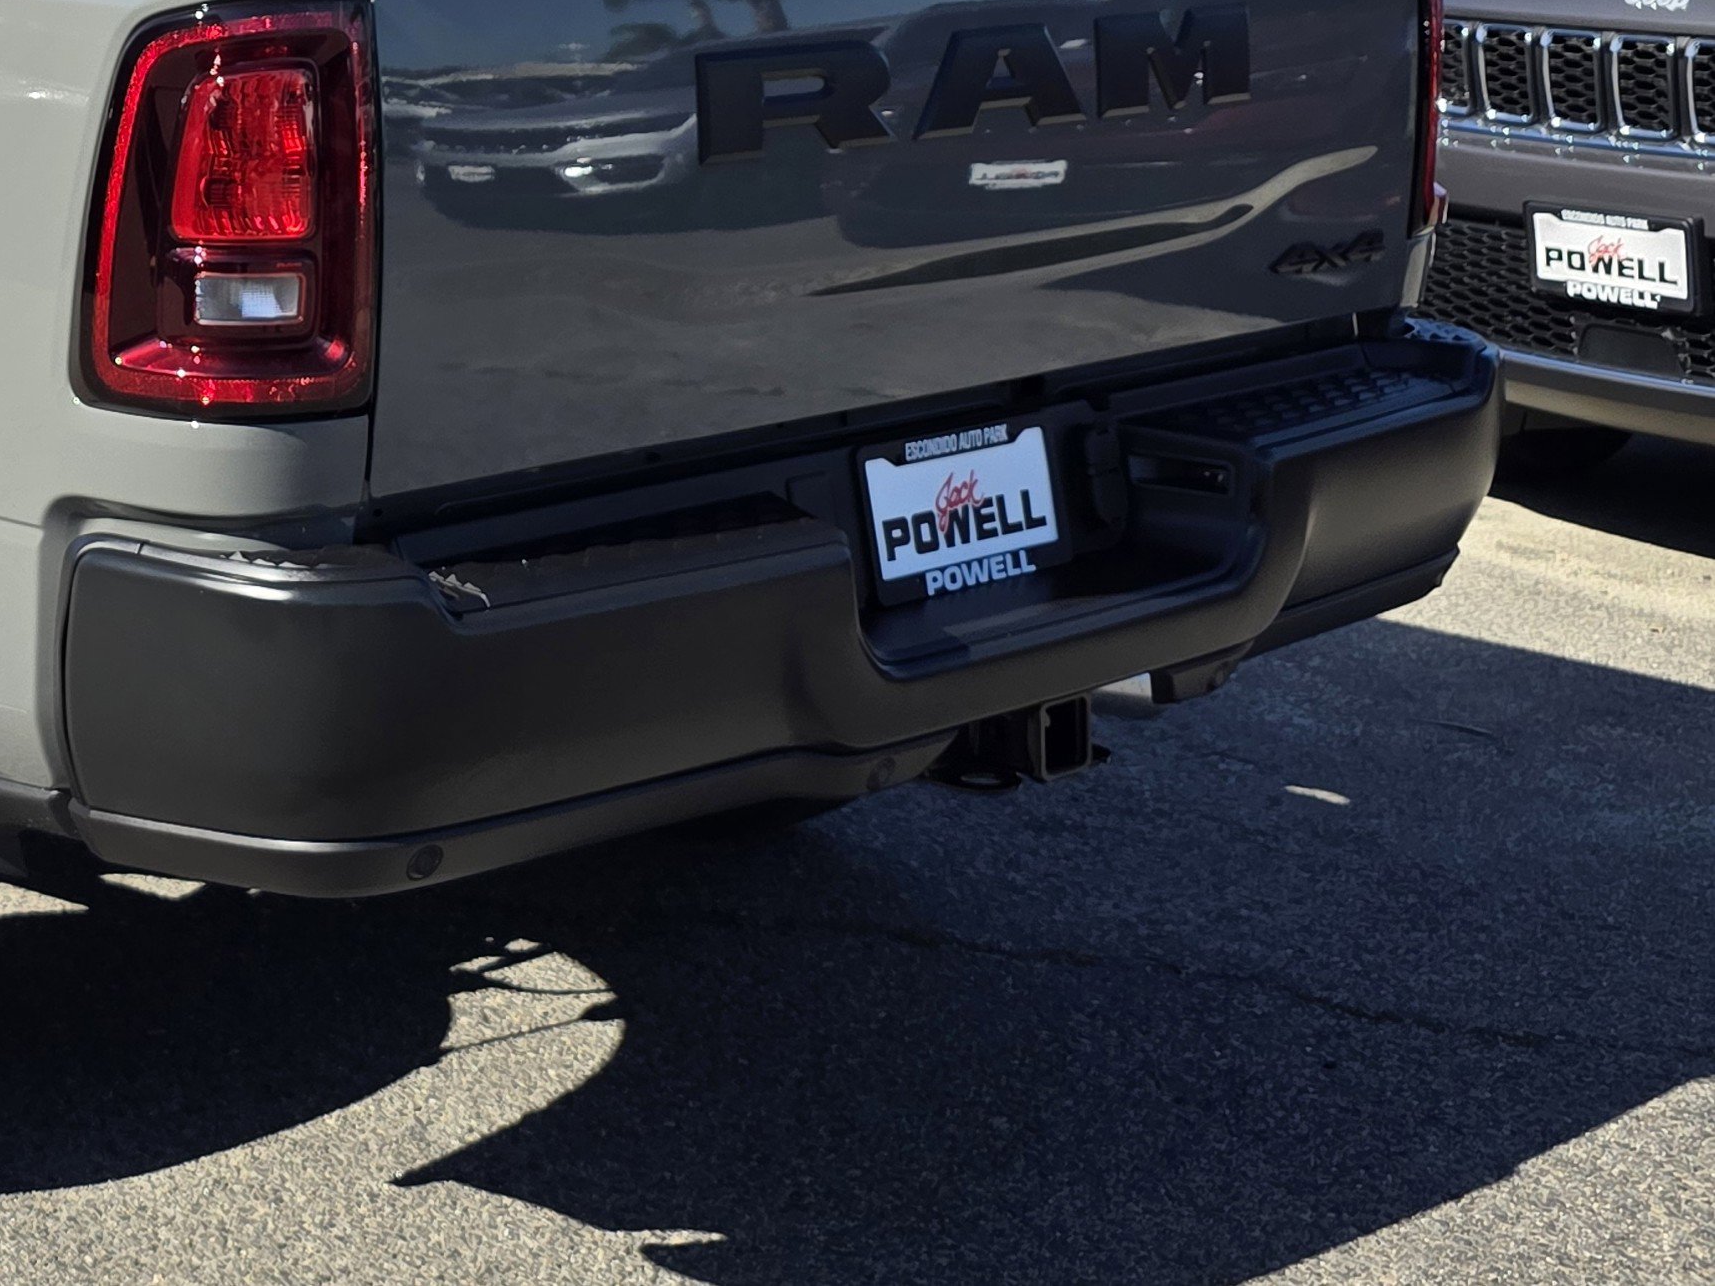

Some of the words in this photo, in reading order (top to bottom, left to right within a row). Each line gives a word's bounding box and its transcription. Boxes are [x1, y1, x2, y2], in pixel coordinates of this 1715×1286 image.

[695, 3, 1252, 166] RAM
[1544, 246, 1678, 285] POWELL
[1566, 280, 1661, 310] POWELL
[904, 433, 958, 462] ESCONDIDO
[959, 428, 983, 451] AUTO
[983, 423, 1008, 445] PARK
[882, 488, 1047, 562] POWELL
[936, 469, 984, 533] Jack
[925, 549, 1037, 597] POWELL
